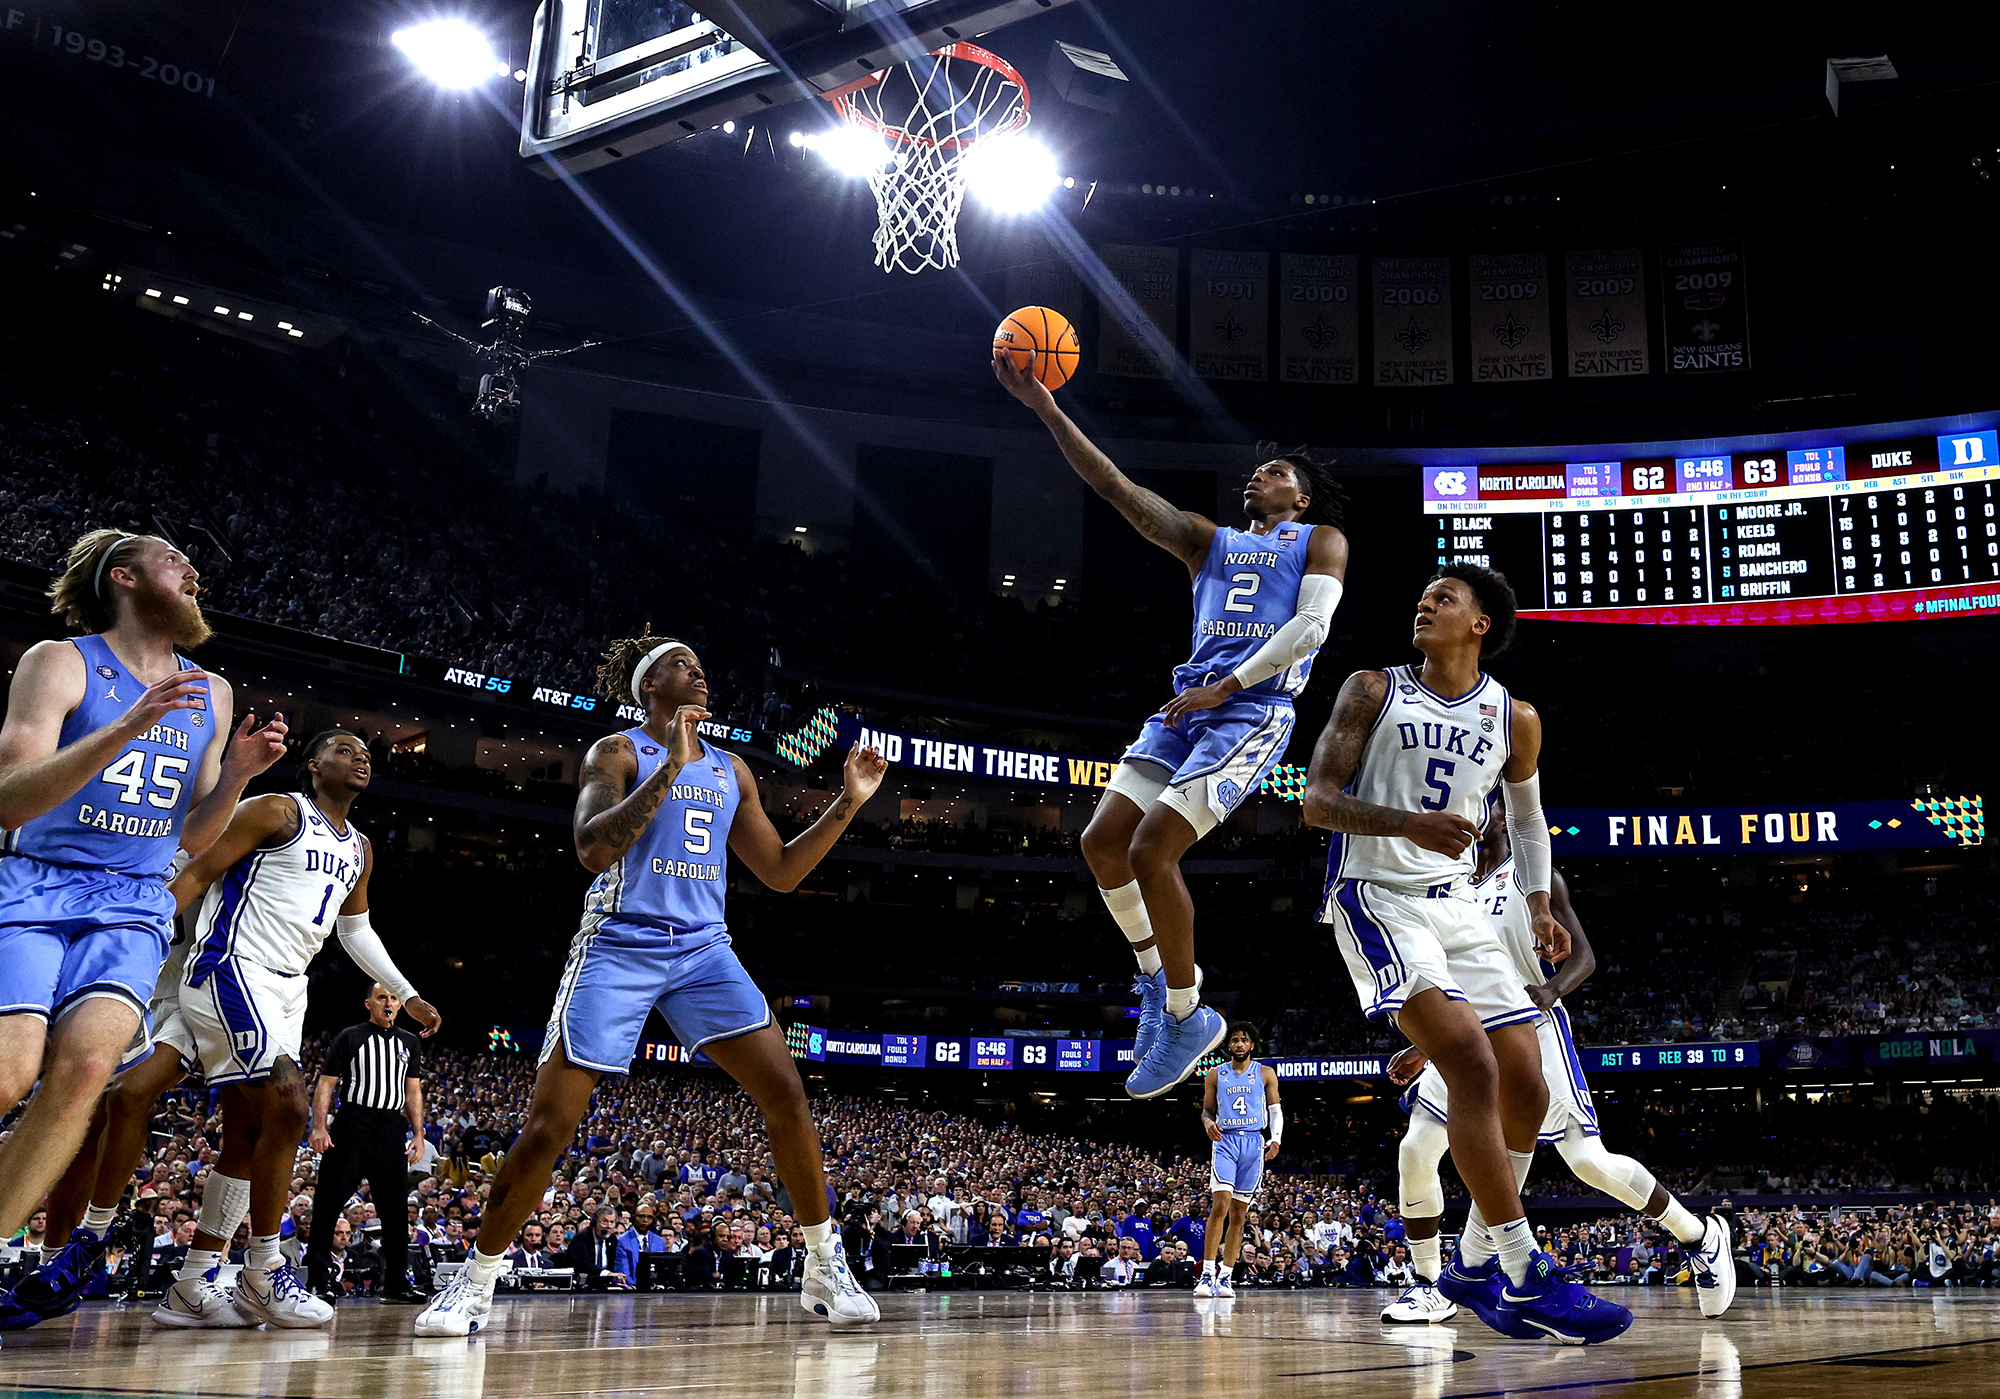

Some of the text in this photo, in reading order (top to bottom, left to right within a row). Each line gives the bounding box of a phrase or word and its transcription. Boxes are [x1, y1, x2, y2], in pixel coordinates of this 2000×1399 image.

[52, 24, 216, 99] 1993-2001
[1680, 244, 1724, 256] WORLD
[1667, 254, 1738, 268] CHAMPIONS
[1204, 281, 1254, 299] 1991
[1576, 278, 1635, 296] 2009
[1674, 271, 1733, 291] 2009
[1290, 284, 1349, 302] 2000
[1382, 286, 1442, 306] 2006
[1480, 282, 1539, 302] 2009
[1673, 342, 1742, 354] NEW ORLEANS
[1196, 361, 1262, 378] SAINTS
[1574, 358, 1644, 374] SAINTS
[1673, 352, 1743, 370] SAINTS
[1286, 365, 1353, 382] SAINTS
[1379, 367, 1448, 386] SAINTS
[1478, 363, 1546, 380] SAINTS
[1804, 450, 1832, 461] TOL 1
[1871, 450, 1912, 468] DUKE
[1583, 465, 1610, 475] TOL 3
[1683, 459, 1724, 478] 6:46
[1744, 459, 1777, 484] 63
[1794, 461, 1834, 472] FOULS 2
[1479, 475, 1565, 491] NORTH CAROLINA
[1573, 476, 1610, 486] FOULS 7
[1632, 466, 1665, 490] 62
[1704, 480, 1723, 490] HALF
[1792, 472, 1822, 483] BONUS
[1570, 487, 1598, 496] BONUS
[1744, 490, 1768, 498] COURT
[1464, 502, 1487, 510] COURT
[1719, 493, 1906, 520] 0 MOORE JR. 7 6 3
[1439, 514, 1614, 530] 1 BLACK 8 6 1
[1722, 512, 1907, 539] 1 KEELS 15 1 0
[1437, 532, 1615, 549] 2 LOVE 18 2 1
[1722, 532, 1909, 558] 3 ROACH 6 5 5
[1223, 551, 1278, 568] NORTH
[1438, 556, 1446, 566] 4
[1552, 553, 1565, 566] 16
[1581, 552, 1590, 565] 5
[1609, 551, 1618, 564] 4
[1723, 551, 1910, 577] 5 BANCHERO 19 7 0
[1553, 570, 1618, 585] 10 19 0
[1721, 571, 1911, 597] 21 GRIFFIN 2 2 1
[1224, 572, 1260, 613] 2
[1553, 589, 1619, 604] 10 2 0
[1201, 619, 1276, 639] CAROLINA
[444, 667, 512, 693] AT&T 5G
[532, 686, 596, 711] AT&T 5G
[616, 704, 646, 723] AT&
[130, 724, 188, 752] ORTH
[696, 720, 752, 743] AT&T 5G
[1397, 722, 1493, 766] DUKE
[859, 726, 902, 763] AND
[911, 737, 974, 773] THEN
[982, 747, 1059, 783] THERE
[101, 749, 190, 810] 45
[1420, 757, 1456, 811] 5
[670, 784, 724, 809] NORTH
[78, 803, 172, 838] CAROLINA
[1608, 811, 1839, 846] FINAL FOUR
[683, 808, 714, 855] 5
[305, 849, 358, 892] DUKE
[652, 857, 721, 881] CAROLIN
[312, 884, 334, 926] 1
[826, 1040, 881, 1055] NORTH CAROLINA
[887, 1046, 907, 1054] FOULS
[935, 1041, 961, 1062] 62
[977, 1042, 1006, 1056] 6:46
[1023, 1045, 1046, 1064] 63
[1086, 1051, 1091, 1059] 2
[1879, 1037, 1977, 1059] 2022 NOLA
[885, 1055, 907, 1064] BONUS
[990, 1058, 1004, 1066] HALF
[1601, 1047, 1744, 1067] AST 6 REB 39 TO 9
[1276, 1061, 1381, 1077] NORTH CAROLINA
[1226, 1085, 1252, 1095] NORTH
[1232, 1096, 1247, 1115] 4
[1223, 1117, 1258, 1126] CAROLINA
